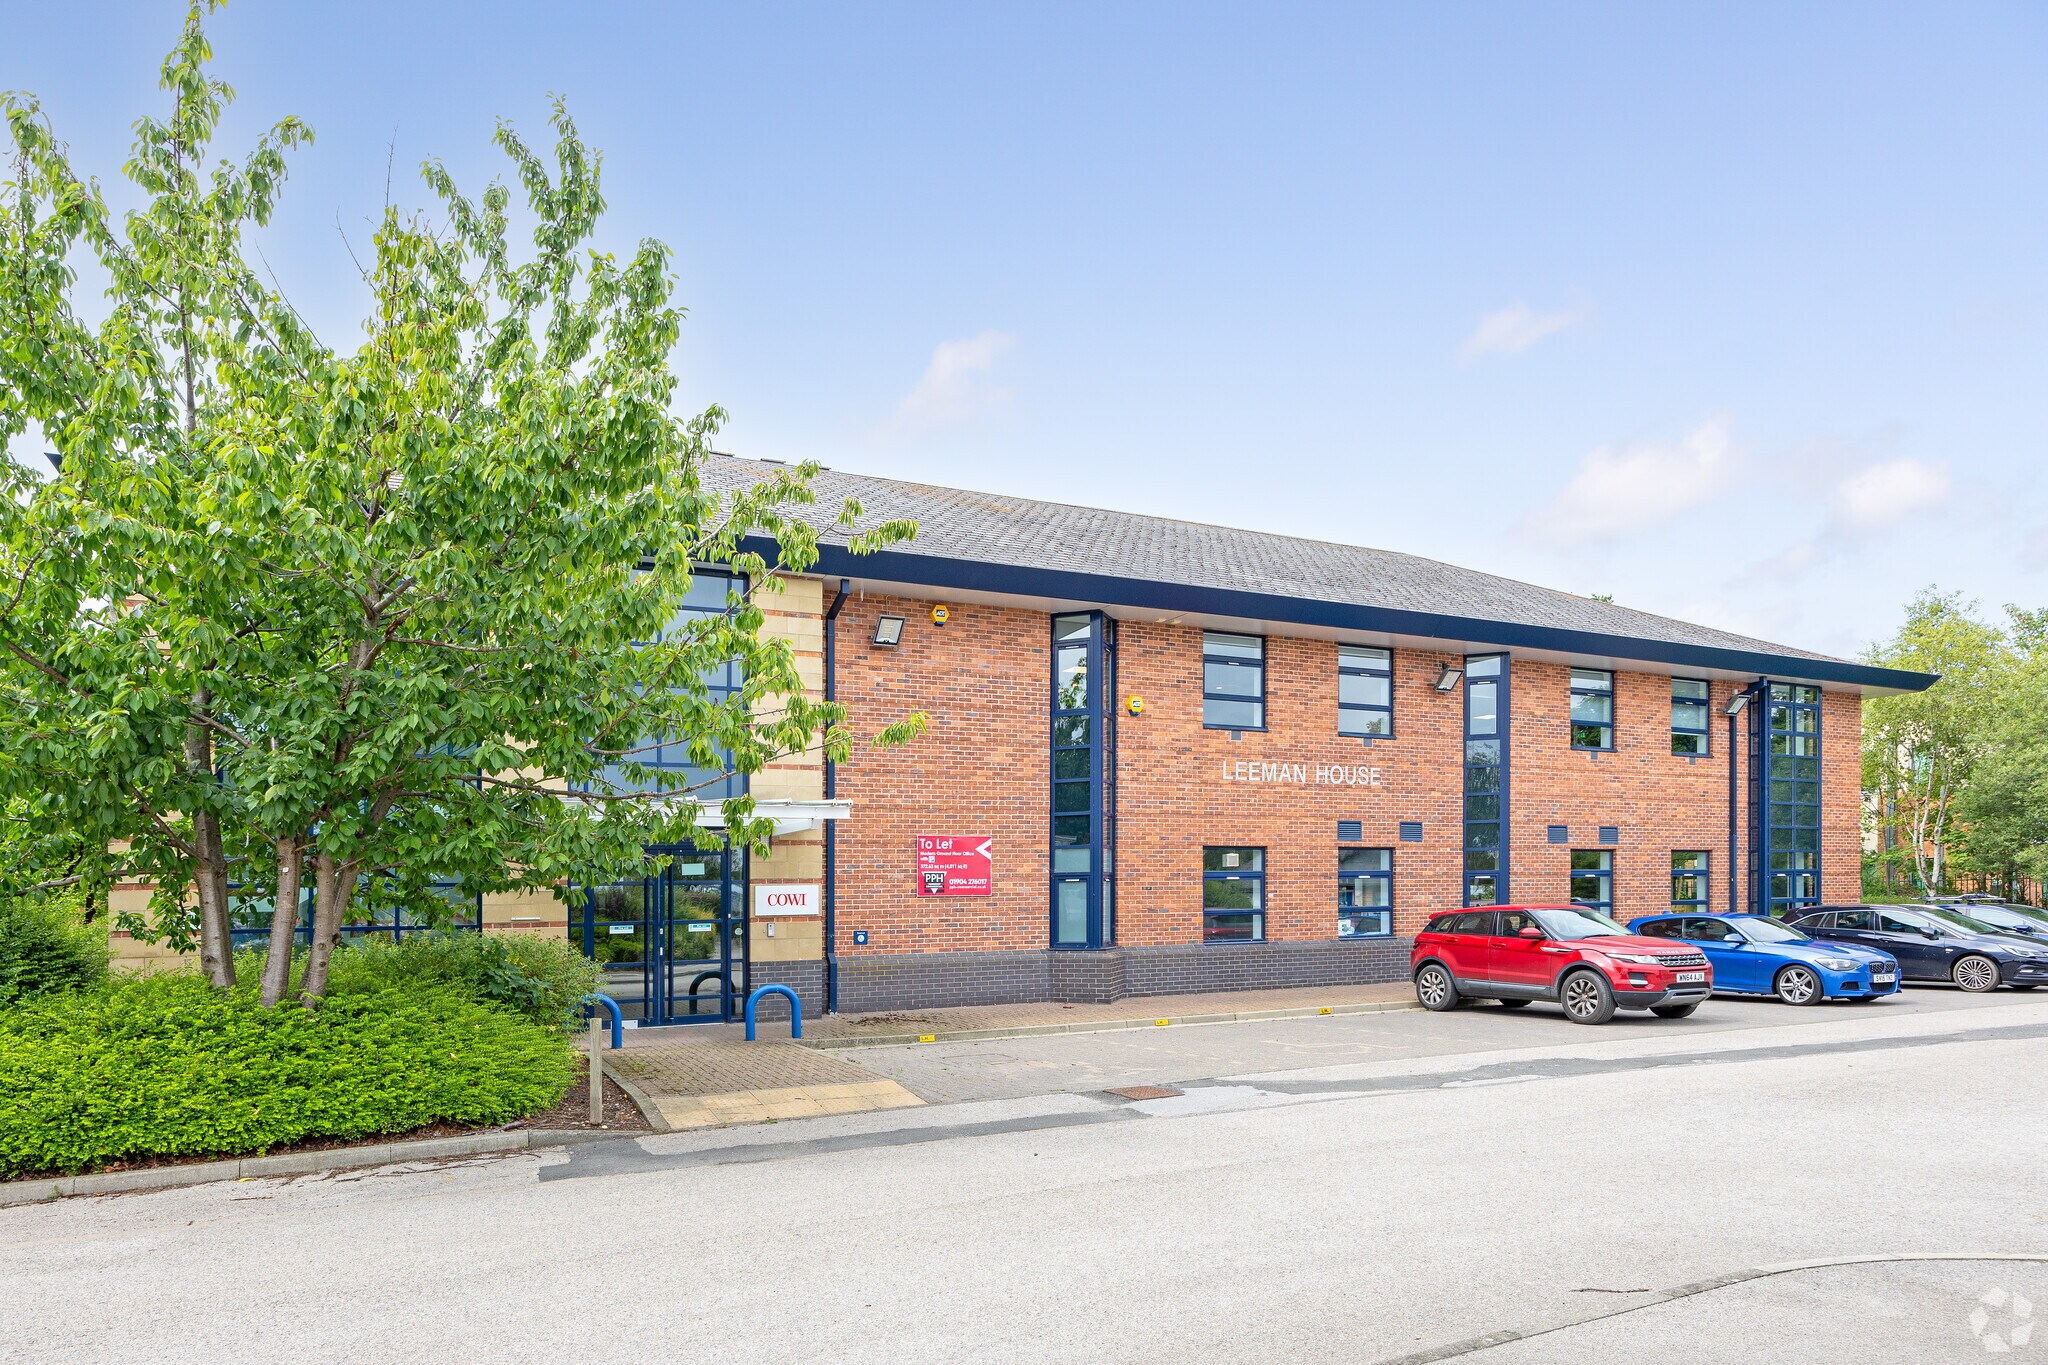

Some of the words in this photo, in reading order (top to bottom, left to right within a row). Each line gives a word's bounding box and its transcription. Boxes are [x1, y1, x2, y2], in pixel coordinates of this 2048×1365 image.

[1222, 760, 1307, 784] LEEMAN
[1315, 764, 1381, 786] HOUSE
[920, 838, 933, 849] To
[936, 838, 953, 849] Let
[925, 874, 944, 883] PPH
[767, 893, 807, 907] COWI
